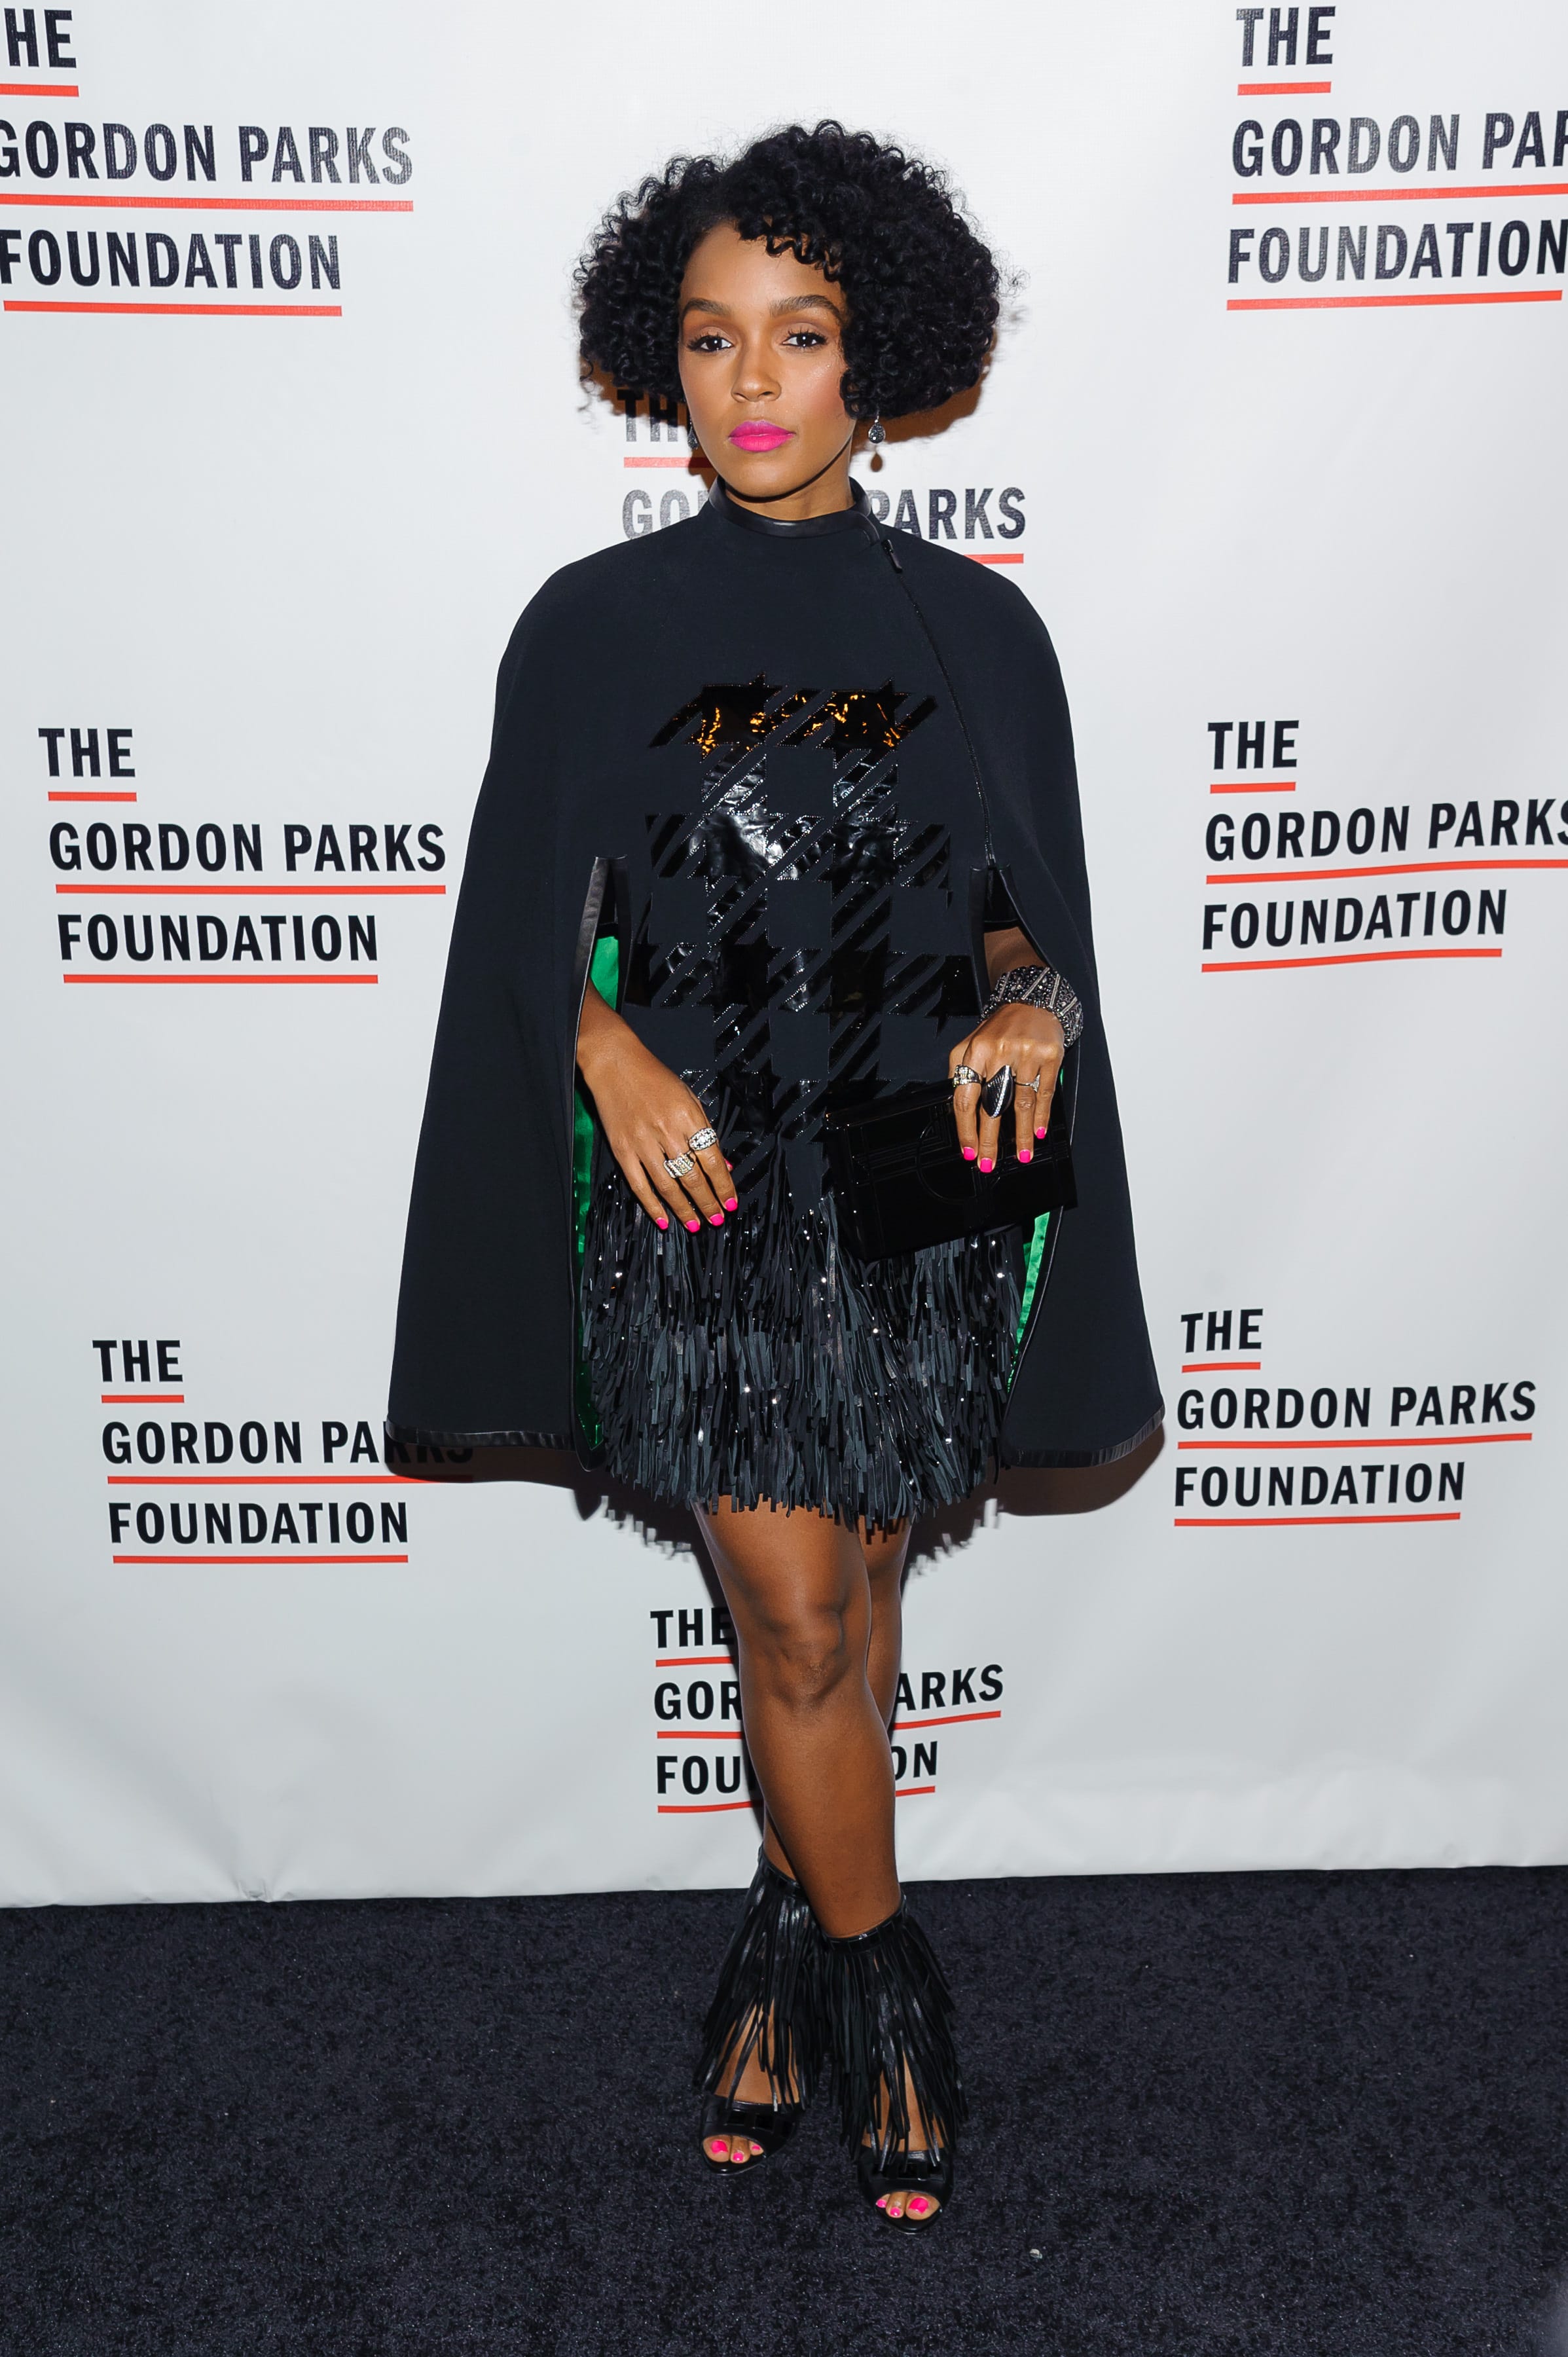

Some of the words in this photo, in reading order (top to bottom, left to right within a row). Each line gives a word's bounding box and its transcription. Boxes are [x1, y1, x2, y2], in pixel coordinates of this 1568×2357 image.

[4, 8, 76, 68] HE
[1237, 7, 1336, 66] THE
[0, 120, 216, 181] GORDON
[239, 126, 410, 184] PARKS
[1233, 115, 1459, 177] GORDON
[1482, 111, 1568, 169] PAR
[0, 230, 340, 289] FOUNDATION
[1229, 219, 1568, 283] FOUNDATION
[617, 389, 678, 442] TH
[38, 728, 135, 777] THE
[1208, 720, 1299, 769] THE
[50, 822, 263, 871] GORDON
[284, 824, 445, 871] PARKS
[1206, 806, 1409, 861] GORDON
[58, 914, 377, 961] FOUNDATION
[1203, 890, 1506, 950] FOUNDATION
[1181, 1309, 1263, 1353] THE
[92, 1340, 183, 1382] THE
[1178, 1388, 1370, 1429] GORDON
[1391, 1381, 1536, 1427] PARKS
[103, 1421, 301, 1464] GORDON
[1175, 1462, 1465, 1507] FOUNDATION
[109, 1502, 407, 1544] FOUNDATION
[650, 1608, 733, 1648] THE
[654, 1681, 741, 1720] GOR
[895, 1664, 1003, 1711] ARKS
